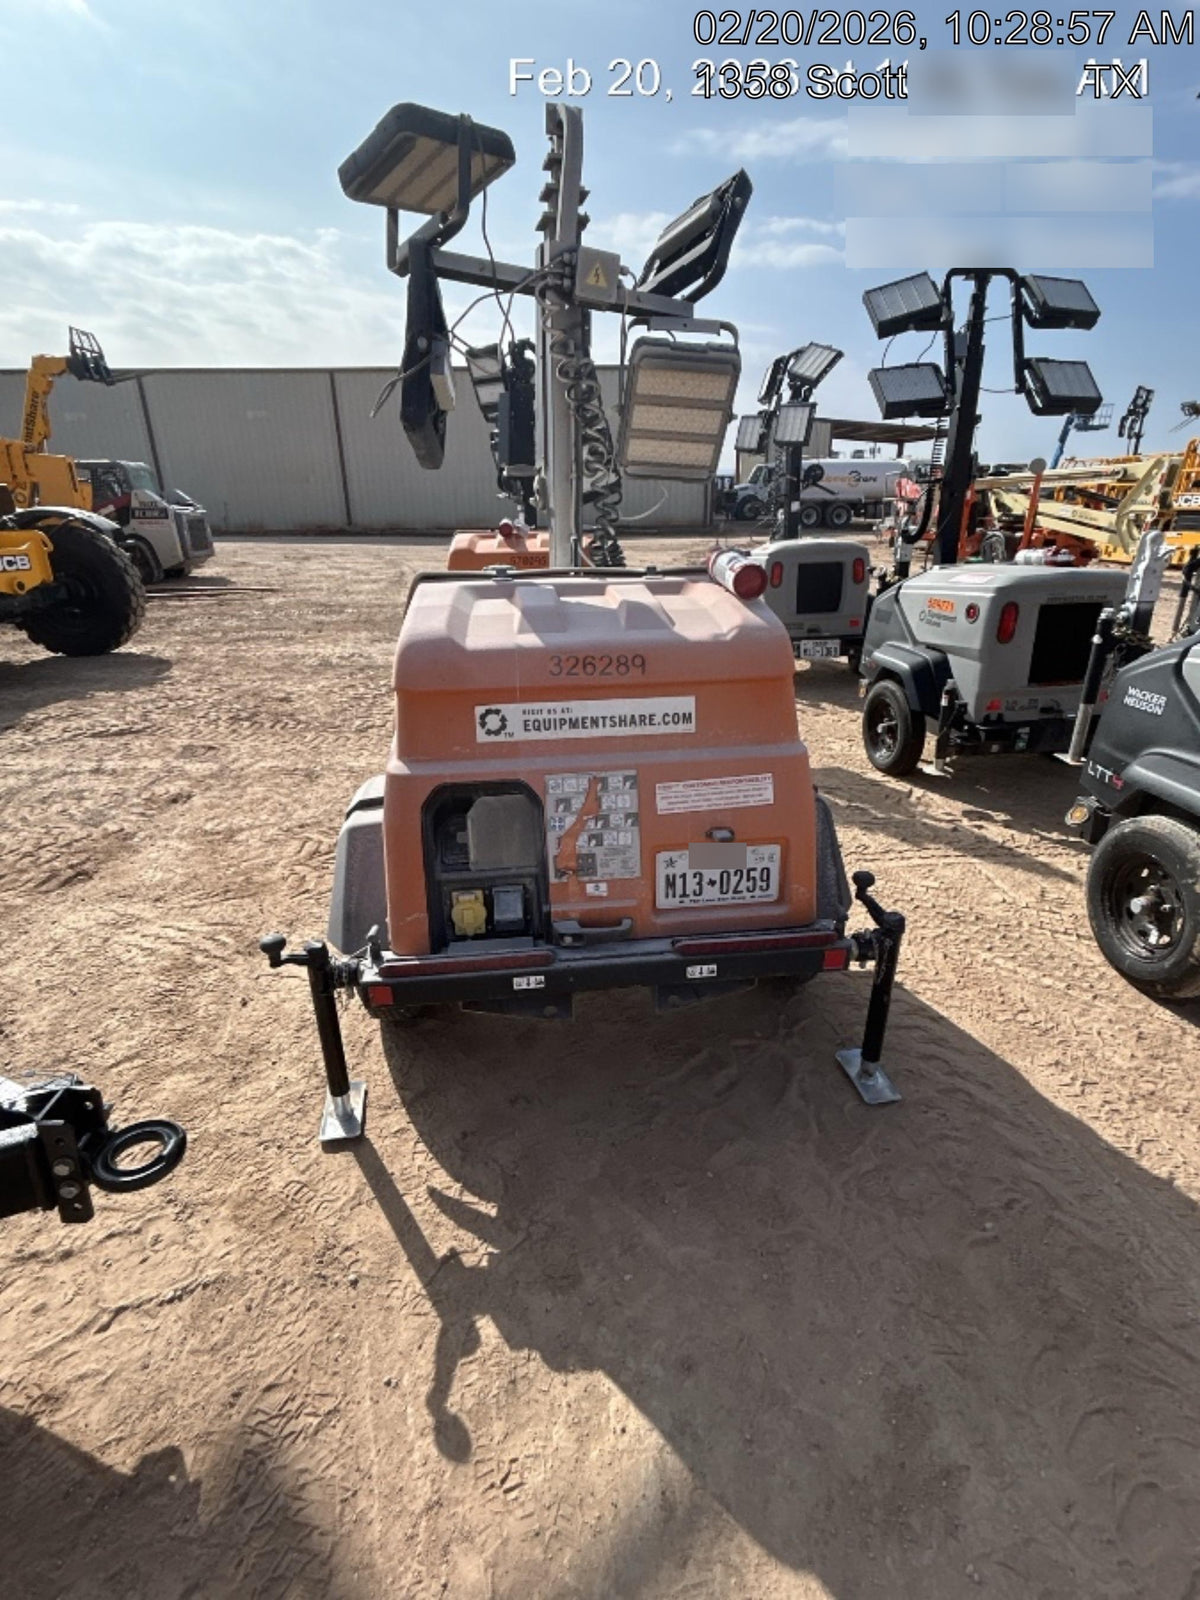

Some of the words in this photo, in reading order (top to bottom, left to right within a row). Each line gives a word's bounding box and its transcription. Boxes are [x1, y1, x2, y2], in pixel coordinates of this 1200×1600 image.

[549, 654, 647, 677] 326289
[1123, 695, 1165, 715] NEUSON
[1128, 685, 1168, 706] WACKER
[523, 712, 693, 733] EQUIPMENTSHARE.COM
